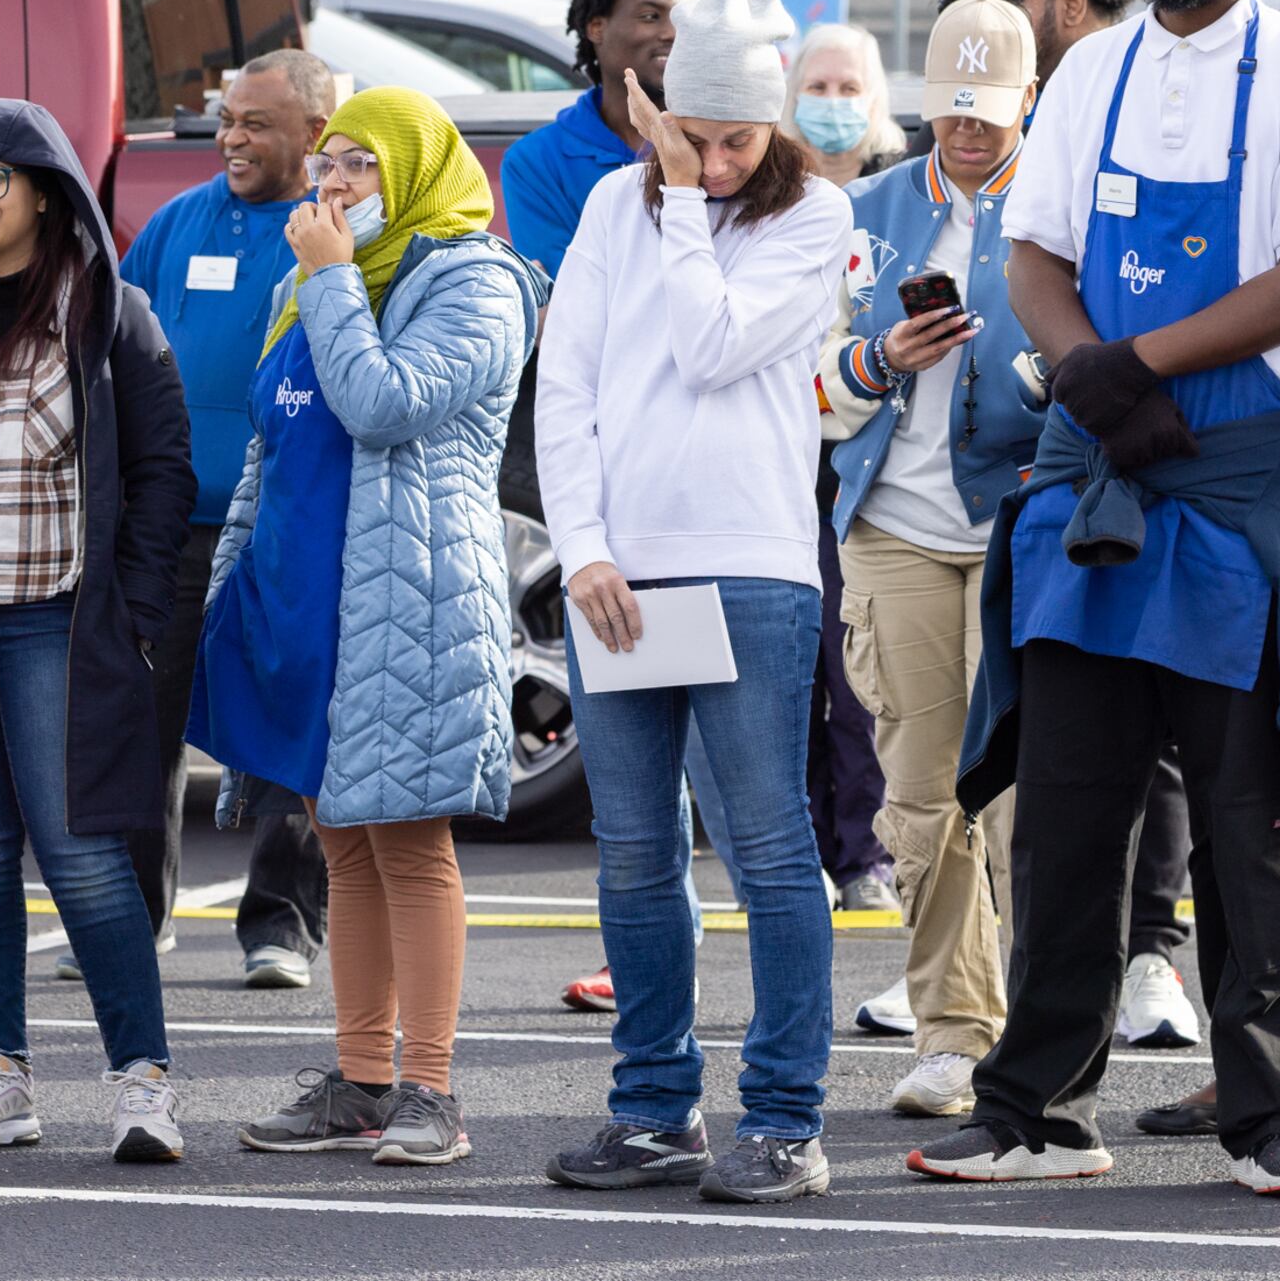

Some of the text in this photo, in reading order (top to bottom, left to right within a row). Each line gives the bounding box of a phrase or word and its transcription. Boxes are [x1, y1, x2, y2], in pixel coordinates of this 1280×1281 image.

[956, 36, 989, 73] NY
[1119, 250, 1166, 294] Kroger
[275, 376, 314, 418] Kroger
